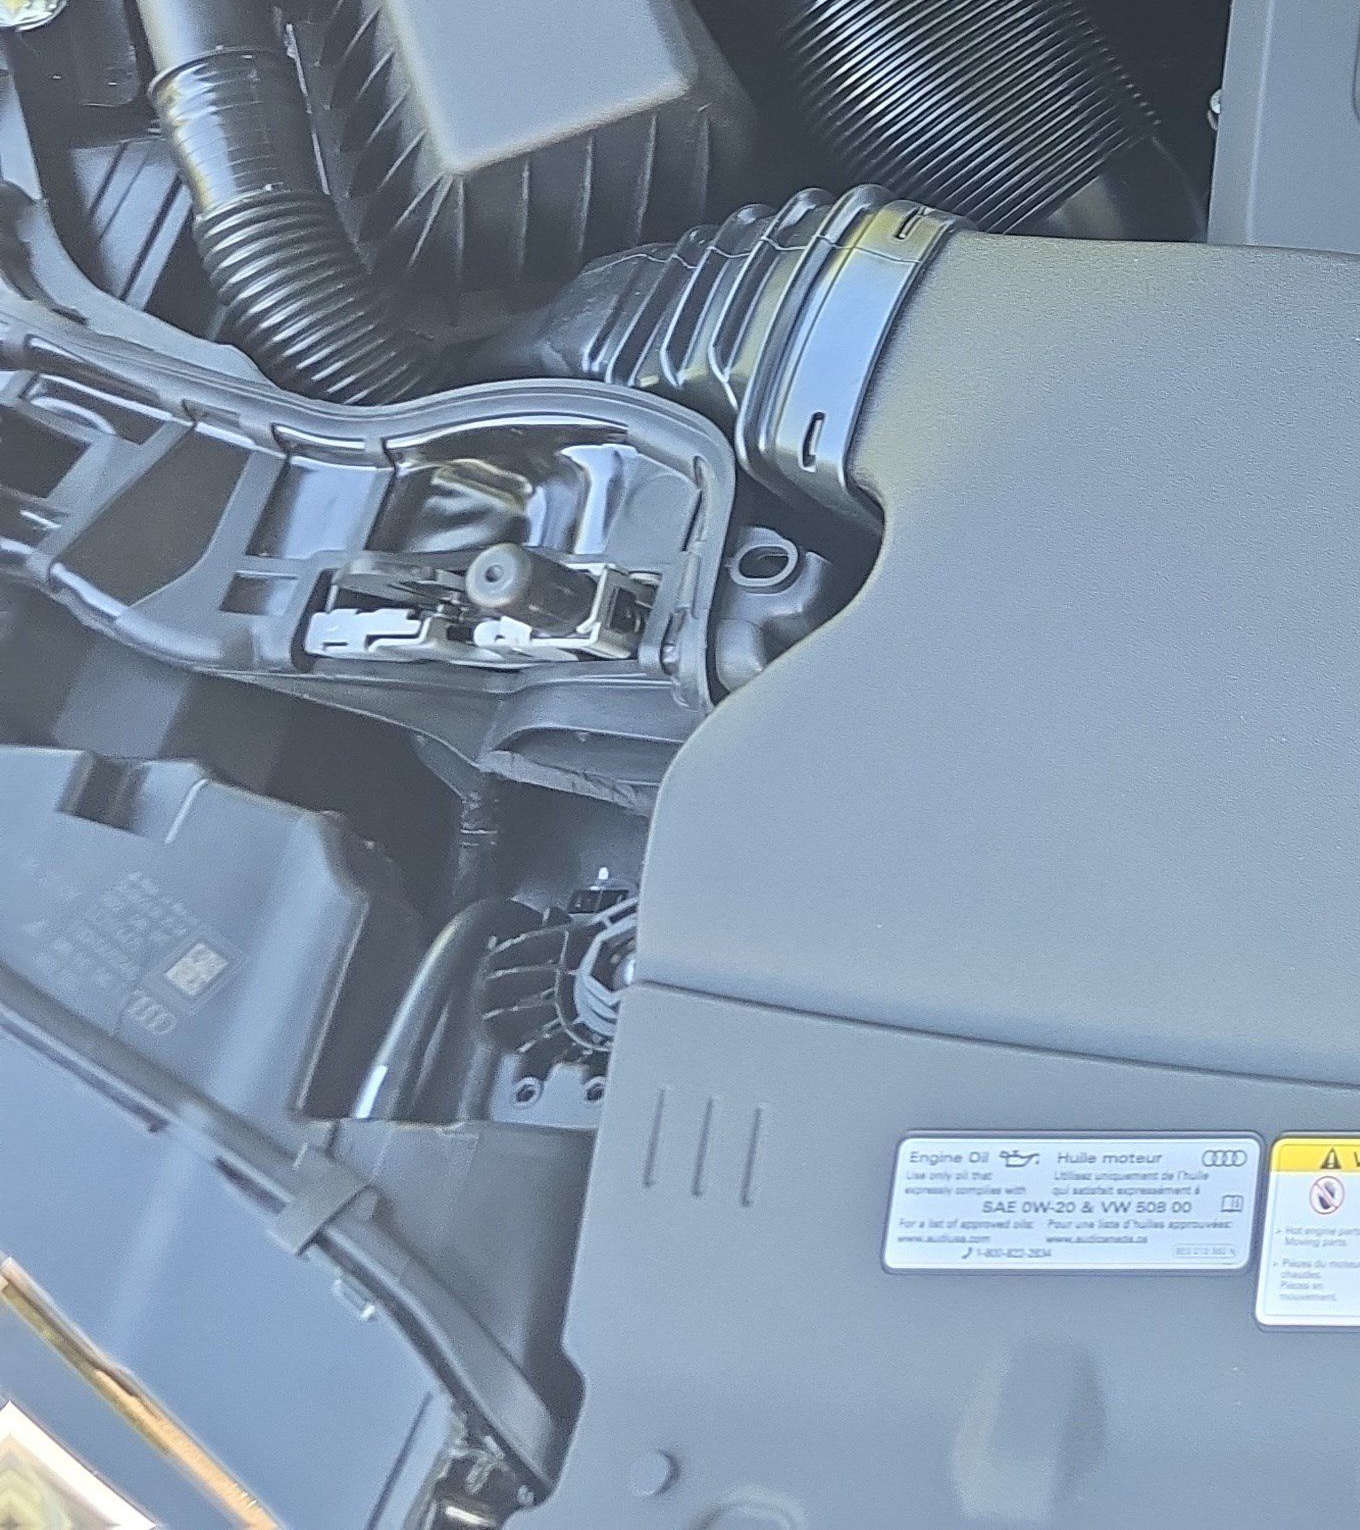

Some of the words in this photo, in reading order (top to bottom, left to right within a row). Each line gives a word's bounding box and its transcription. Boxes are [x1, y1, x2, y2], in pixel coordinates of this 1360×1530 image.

[910, 1151, 963, 1165] Engine
[969, 1151, 989, 1163] Oil
[1058, 1152, 1097, 1163] Huile
[1102, 1152, 1162, 1163] moteur
[982, 1201, 1015, 1213] SAE
[1021, 1201, 1076, 1213] 0W-20
[1082, 1201, 1093, 1213] &
[1101, 1201, 1131, 1213] VW
[1136, 1201, 1165, 1213] 508
[1172, 1201, 1192, 1213] 00
